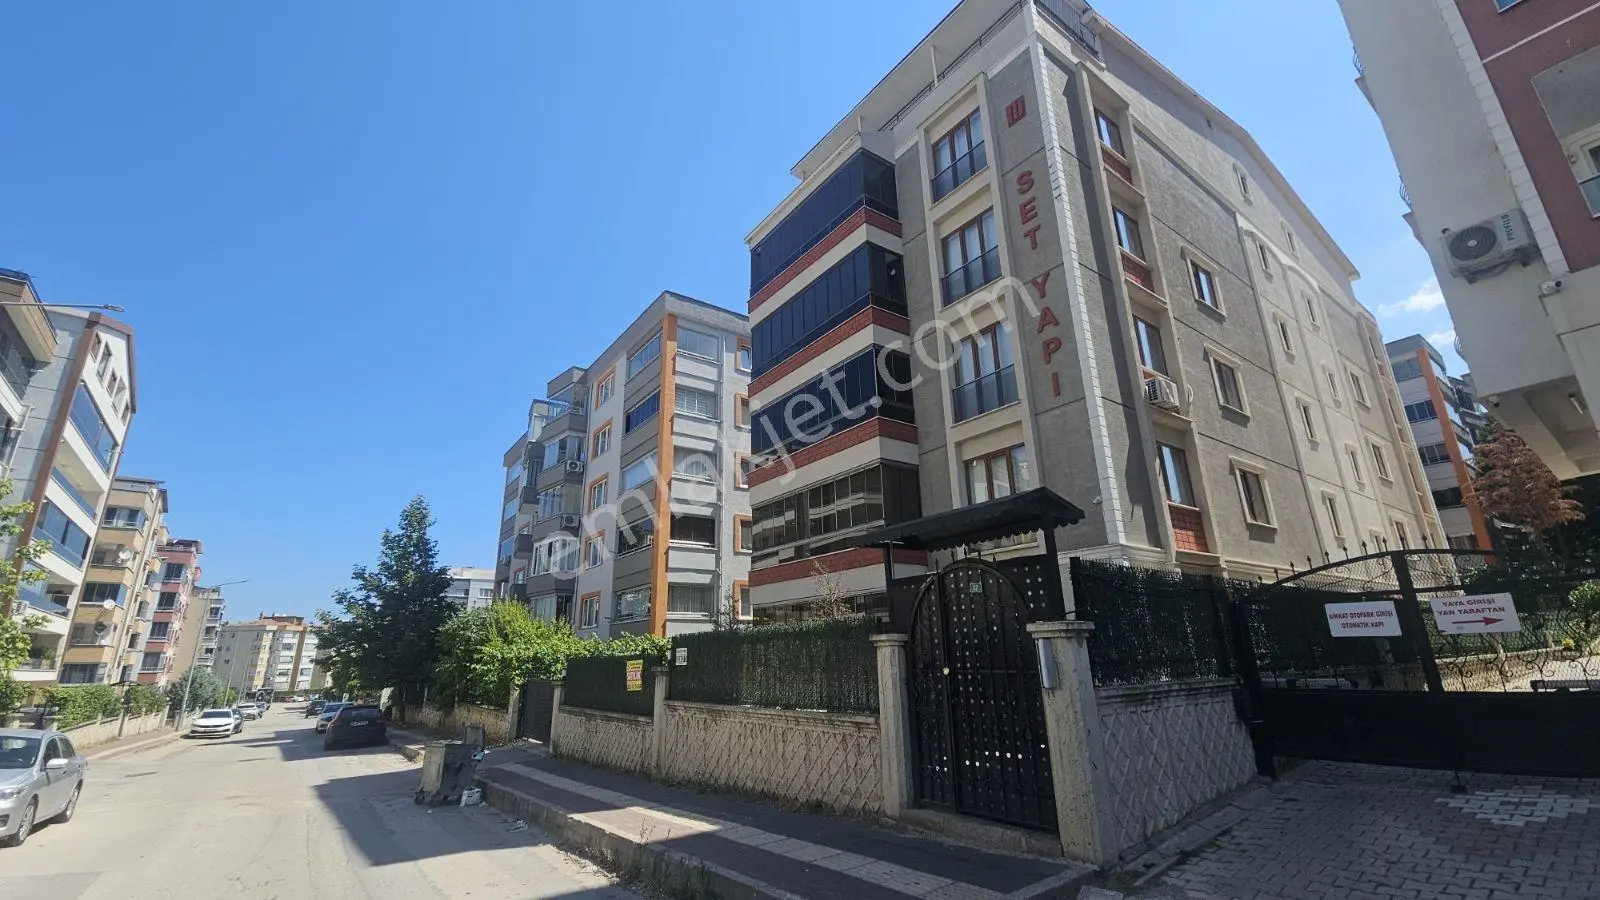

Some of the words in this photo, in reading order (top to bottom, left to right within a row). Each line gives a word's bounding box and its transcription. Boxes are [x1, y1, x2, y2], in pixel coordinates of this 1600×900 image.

[1015, 169, 1042, 250] SET
[1029, 271, 1062, 398] YAPI
[1441, 599, 1465, 607] YAYA
[1457, 606, 1506, 615] TARAFTAN
[1349, 611, 1375, 619] OTOPARK
